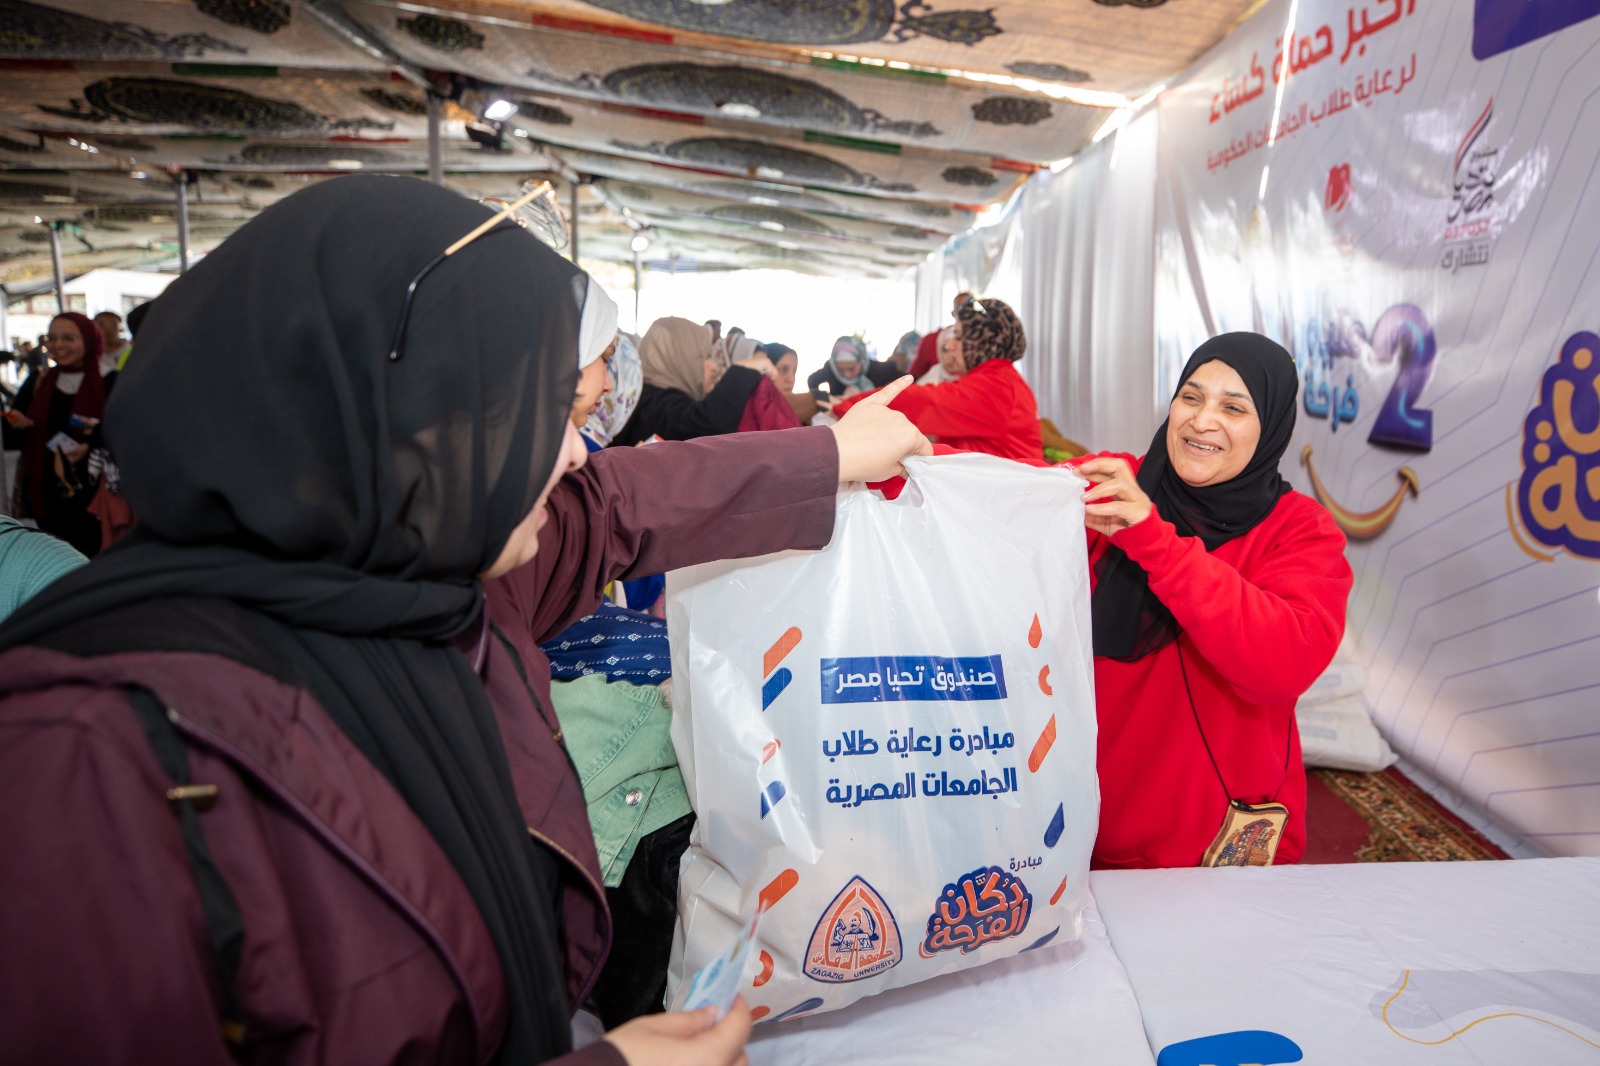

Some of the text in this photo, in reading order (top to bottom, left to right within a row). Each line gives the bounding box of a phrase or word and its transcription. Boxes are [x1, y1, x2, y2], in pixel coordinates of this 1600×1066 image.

[1354, 52, 1416, 108] لرعاية
[1254, 103, 1309, 150] الجامات
[1310, 87, 1353, 128] طلاب
[1366, 302, 1437, 455] 2
[835, 665, 997, 694] صندوق تحيا مصر
[821, 725, 1015, 763] مبادرة رعاية طلاب
[825, 766, 1018, 809] الجامعات المصرية
[1009, 855, 1043, 873] مبادرة
[811, 967, 845, 981] ZAGAZIG
[853, 957, 896, 978] UNIVERSITY
